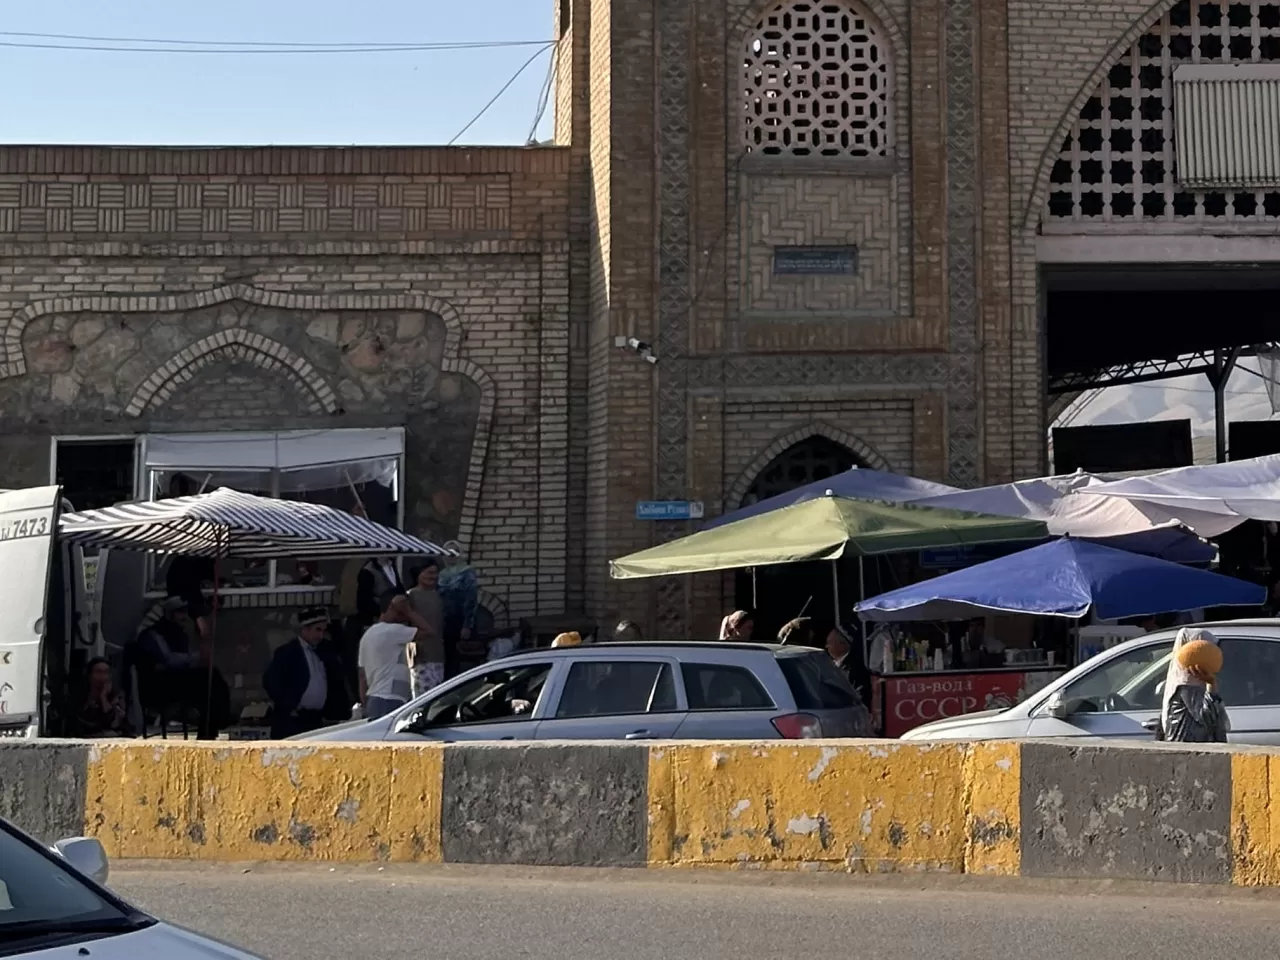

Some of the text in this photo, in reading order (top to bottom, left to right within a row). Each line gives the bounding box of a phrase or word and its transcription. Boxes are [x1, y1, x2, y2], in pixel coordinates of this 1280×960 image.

[13, 516, 48, 540] 7473
[895, 679, 973, 694] Газ-вода
[894, 696, 977, 720] СССР
